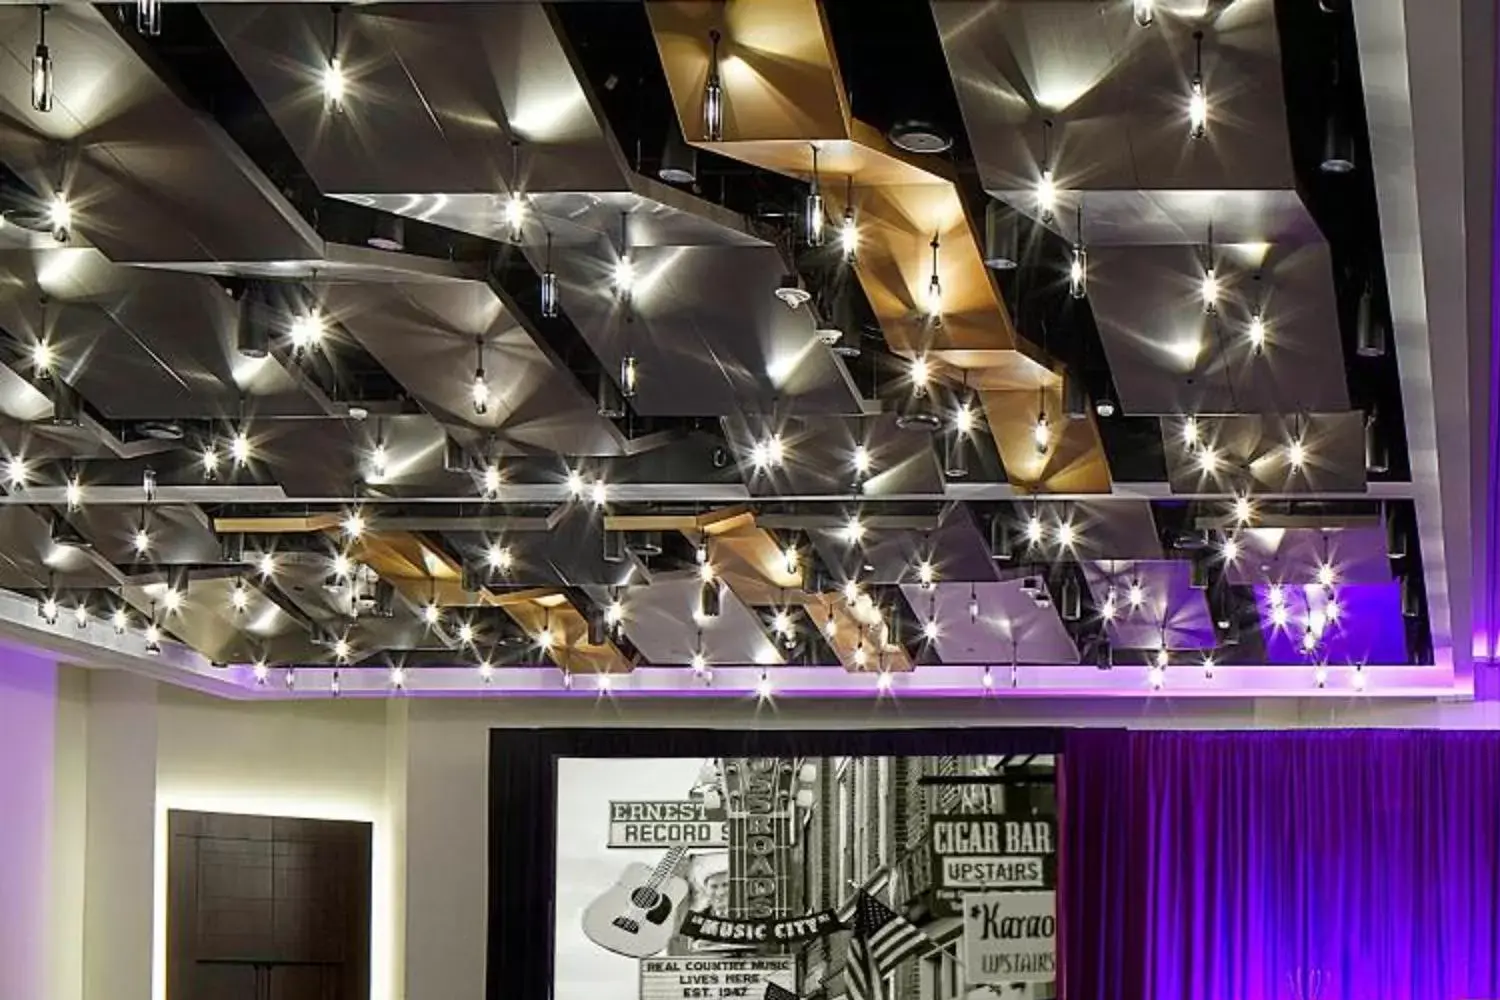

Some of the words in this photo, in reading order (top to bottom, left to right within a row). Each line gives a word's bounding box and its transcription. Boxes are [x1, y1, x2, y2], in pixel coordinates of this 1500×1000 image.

[625, 824, 711, 842] RECORD
[933, 821, 1000, 854] CIGAR
[1005, 821, 1051, 854] BAR
[948, 863, 1039, 881] UPSTAIRS
[647, 961, 681, 972] REAL
[685, 961, 748, 972] COUNTRY
[751, 960, 790, 970] MUSIC
[679, 974, 719, 985] LIVES
[725, 974, 760, 984] HERE
[683, 987, 713, 998] EST.
